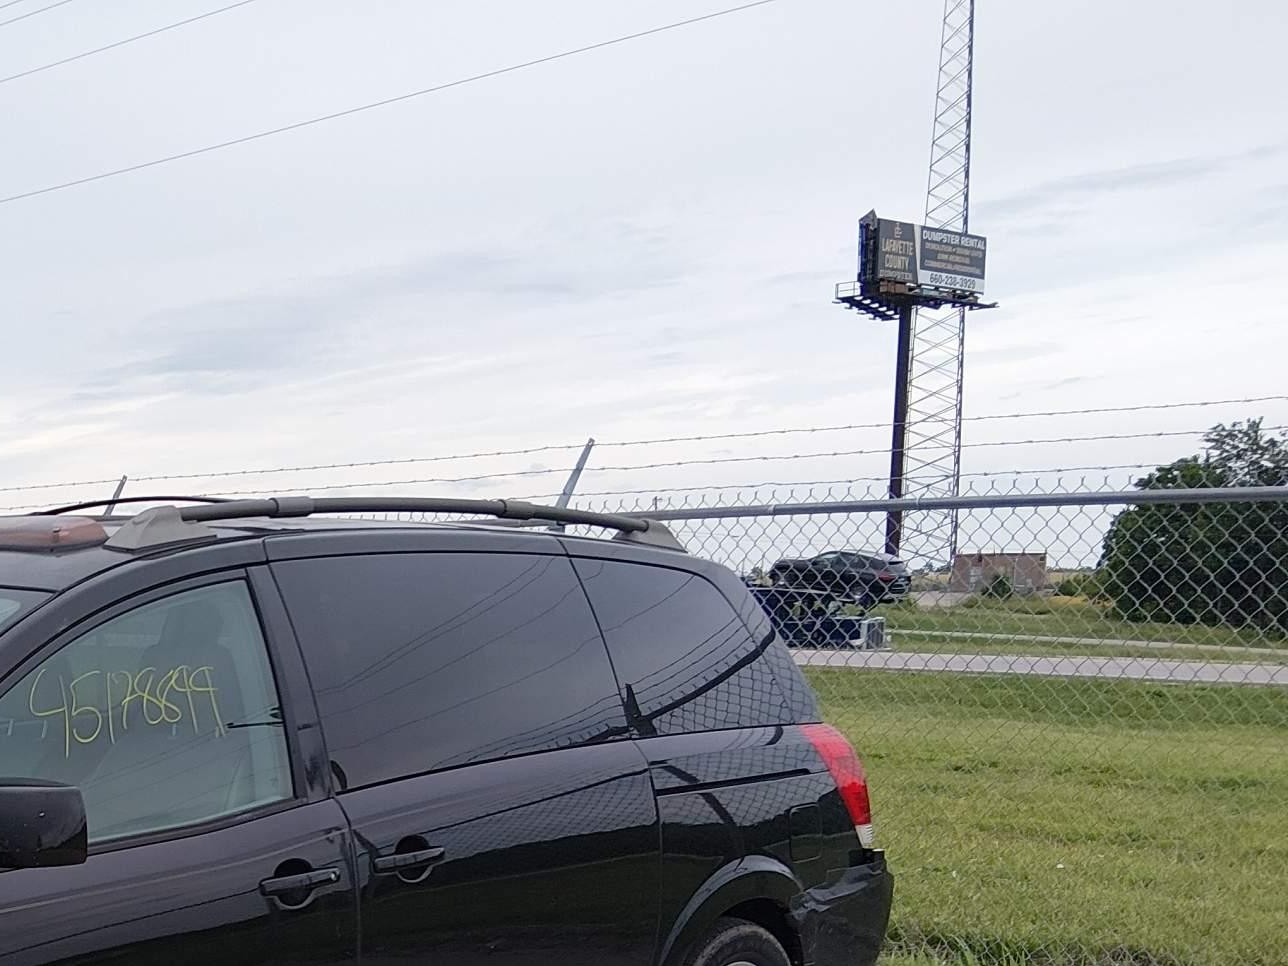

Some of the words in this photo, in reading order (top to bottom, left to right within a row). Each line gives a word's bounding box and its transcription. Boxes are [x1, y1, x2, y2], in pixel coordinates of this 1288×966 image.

[882, 239, 914, 256] LAFAYETTE
[922, 230, 960, 244] DUMPSTER
[961, 237, 985, 250] RENTAL
[885, 255, 910, 271] COUNTY
[29, 665, 226, 760] 45178899
